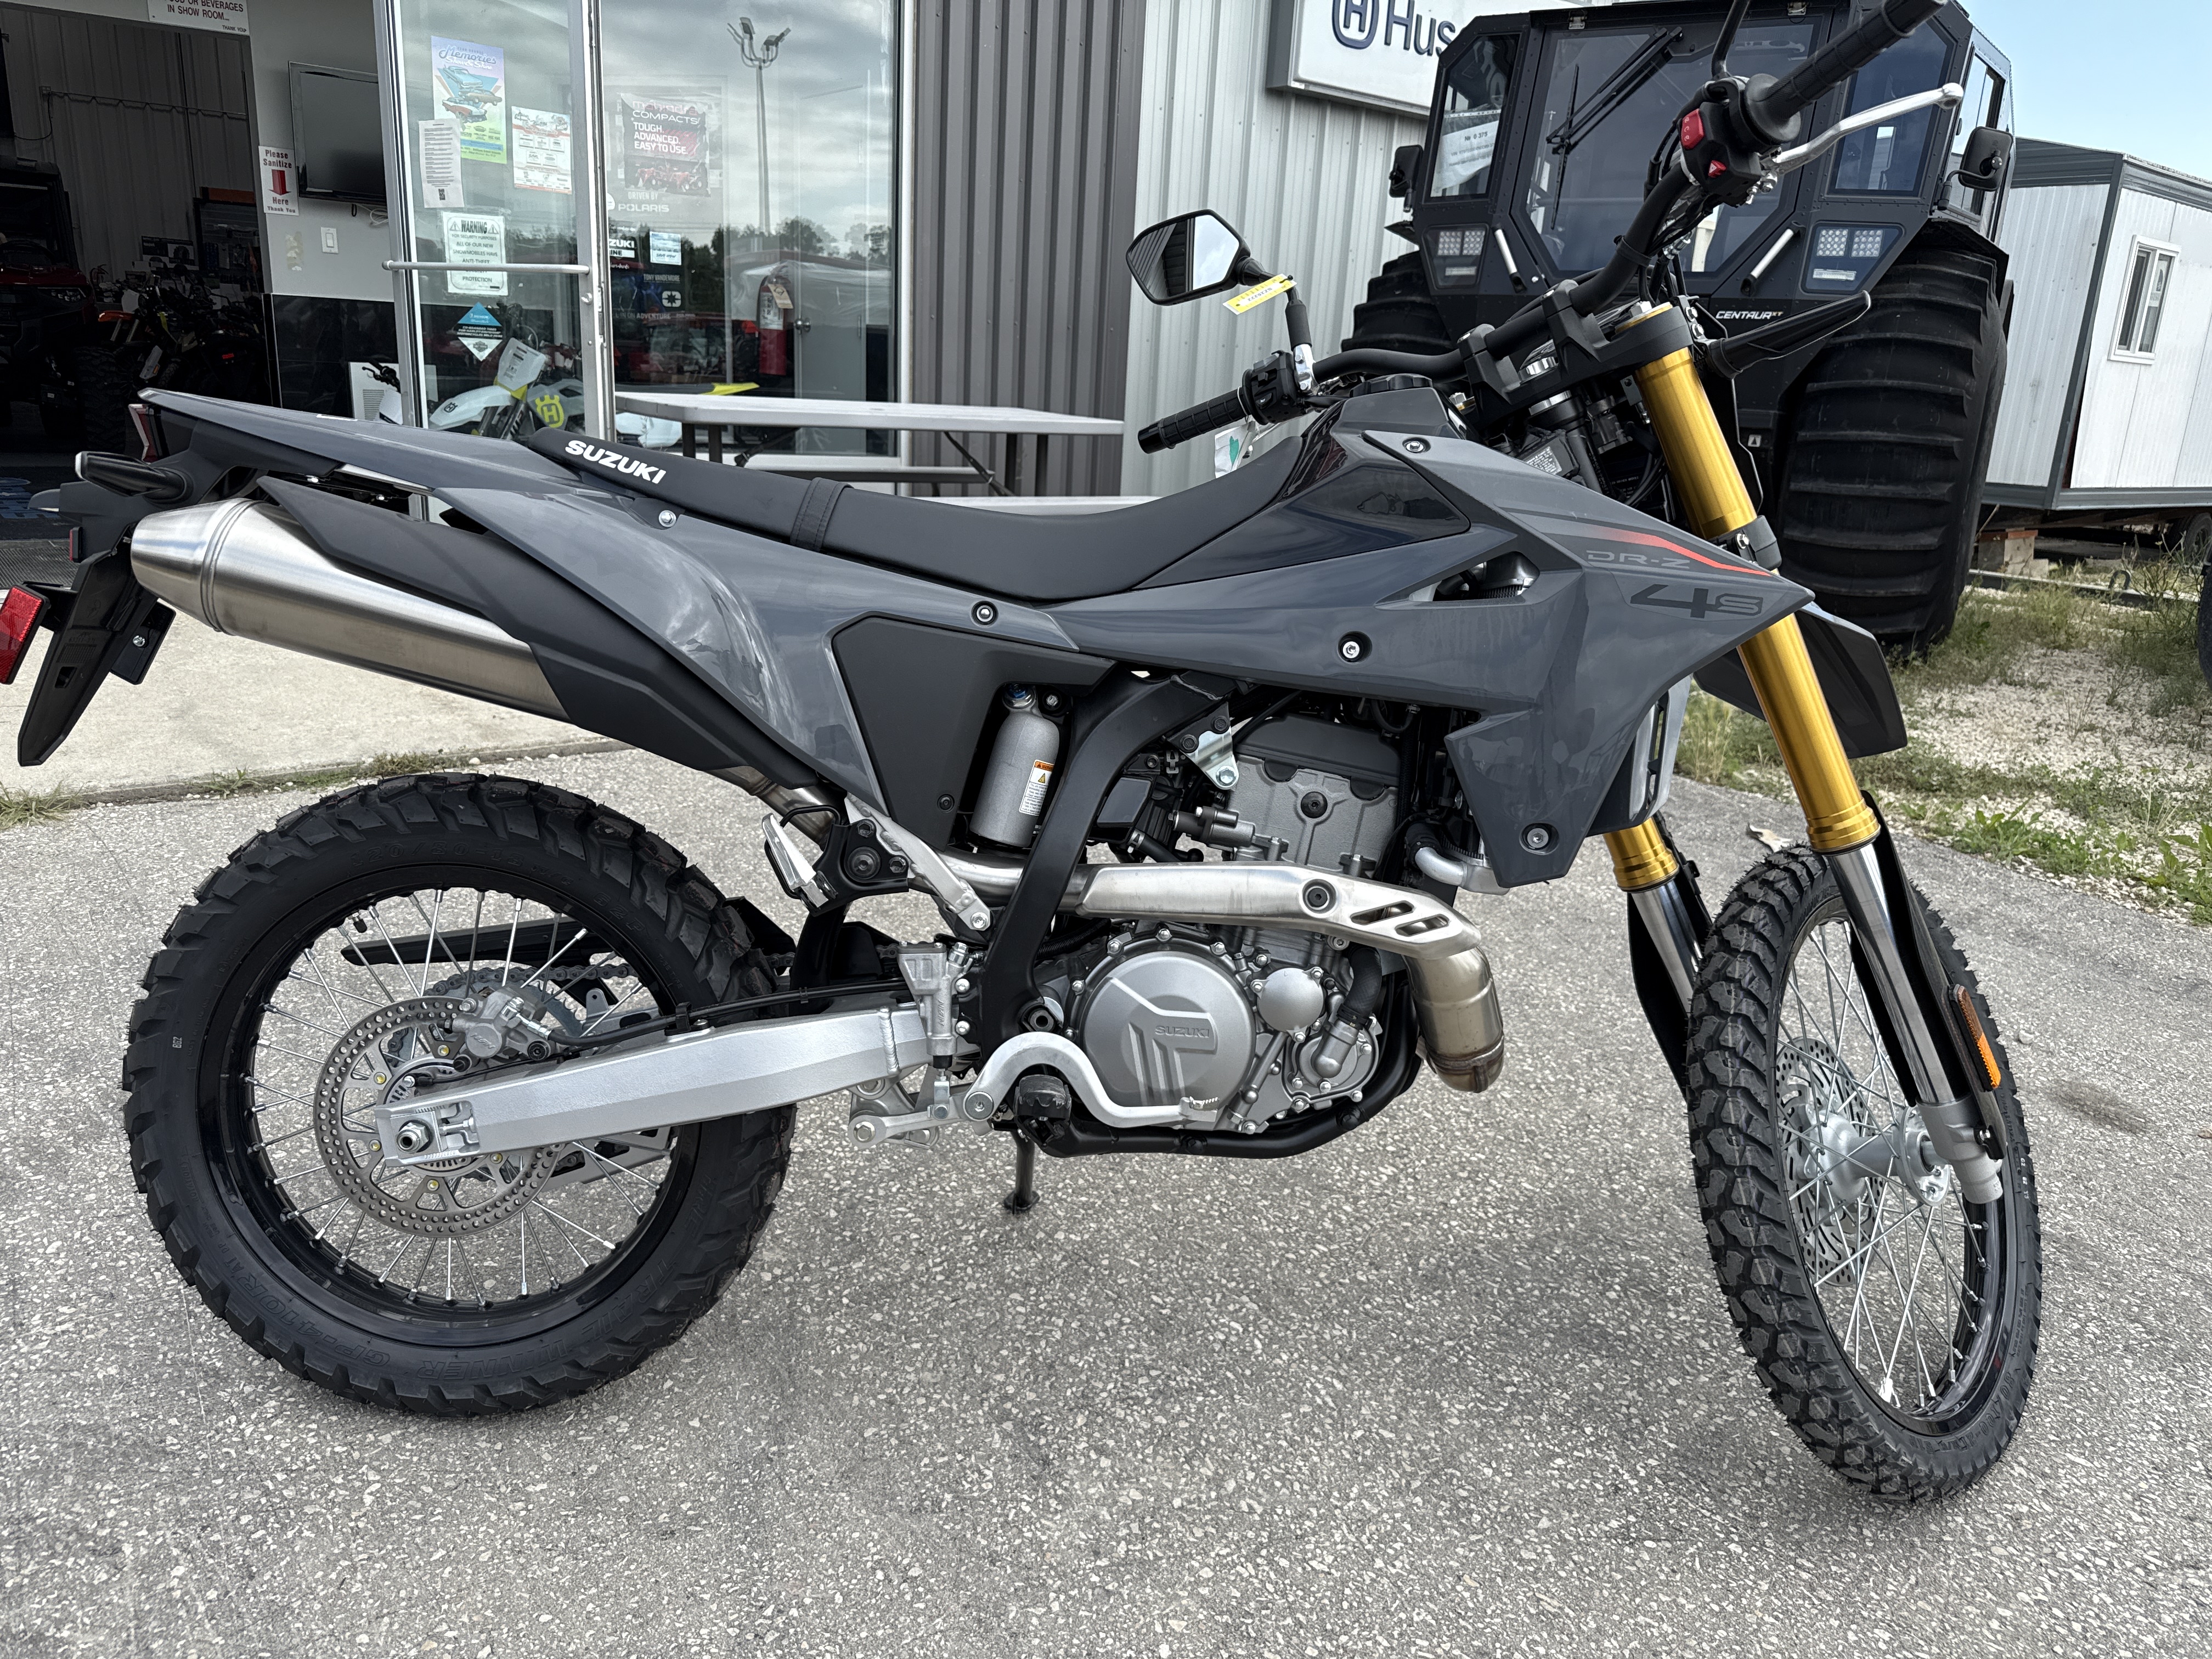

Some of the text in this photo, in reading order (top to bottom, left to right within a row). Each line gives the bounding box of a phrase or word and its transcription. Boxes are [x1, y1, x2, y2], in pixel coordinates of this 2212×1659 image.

[167, 4, 175, 13] IN
[178, 5, 200, 16] SHOW
[201, 0, 244, 12] BEVERAGES
[439, 45, 496, 64] Memories
[633, 110, 698, 125] COMPACTS
[633, 121, 664, 133] TOUGH.
[634, 131, 681, 145] ADVANCED.
[634, 140, 657, 151] EASY
[657, 143, 669, 153] TO
[265, 149, 288, 159] Please
[263, 158, 292, 168] Sanitize
[272, 196, 289, 205] Here
[628, 191, 658, 200] DRIVEN BY
[618, 203, 670, 212] POLARIS
[461, 219, 487, 234] WARNING
[565, 440, 667, 484] SUZUKI
[1586, 550, 1691, 569] DR-Z
[1154, 1025, 1210, 1039] SUZUKI
[578, 1254, 680, 1345] TRAIL
[235, 1269, 392, 1369] GP-410R
[416, 1338, 569, 1380] WINNER
